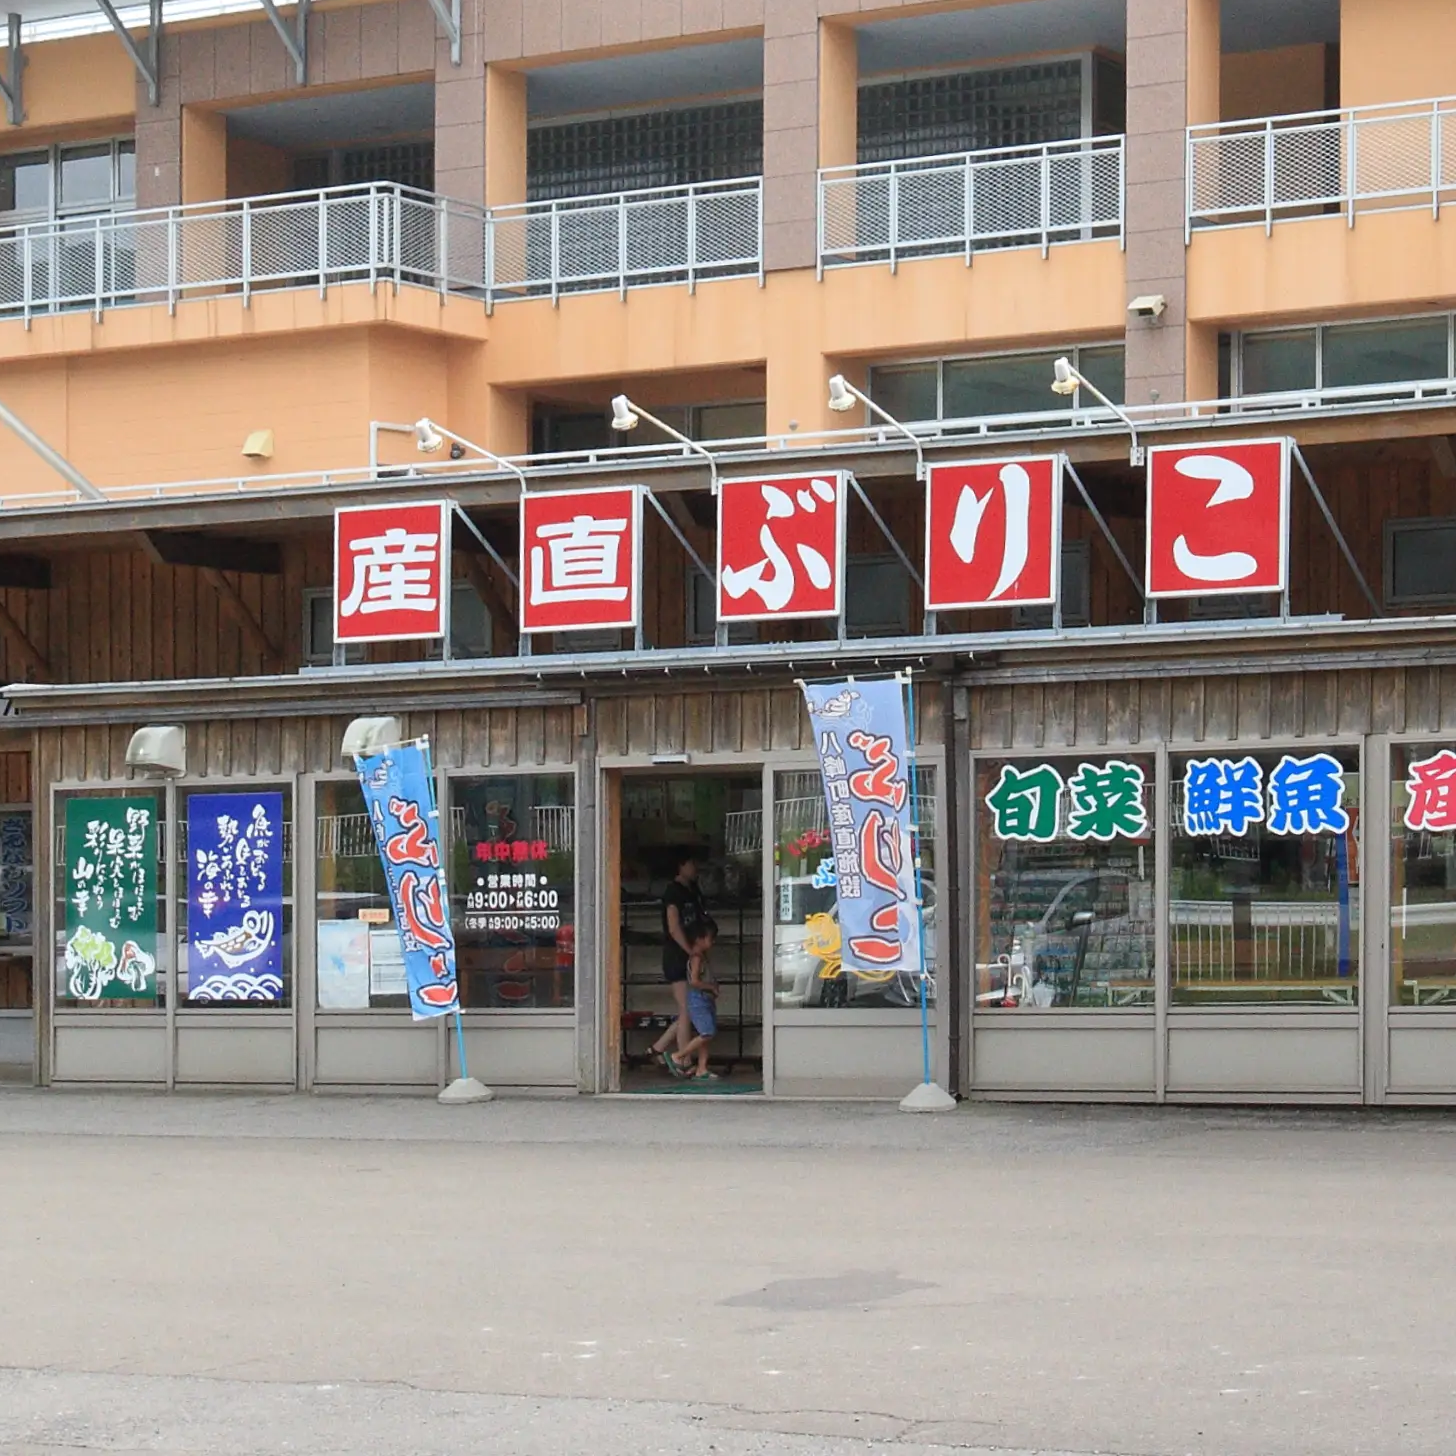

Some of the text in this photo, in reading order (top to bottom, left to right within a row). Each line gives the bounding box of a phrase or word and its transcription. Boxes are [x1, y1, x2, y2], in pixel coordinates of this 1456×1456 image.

[341, 454, 1258, 617] 産直ぶりこ
[985, 759, 1148, 842] 旬菜
[1183, 752, 1349, 837] 鮮魚
[72, 856, 94, 917] 山の幸
[196, 849, 221, 919] 海の幸
